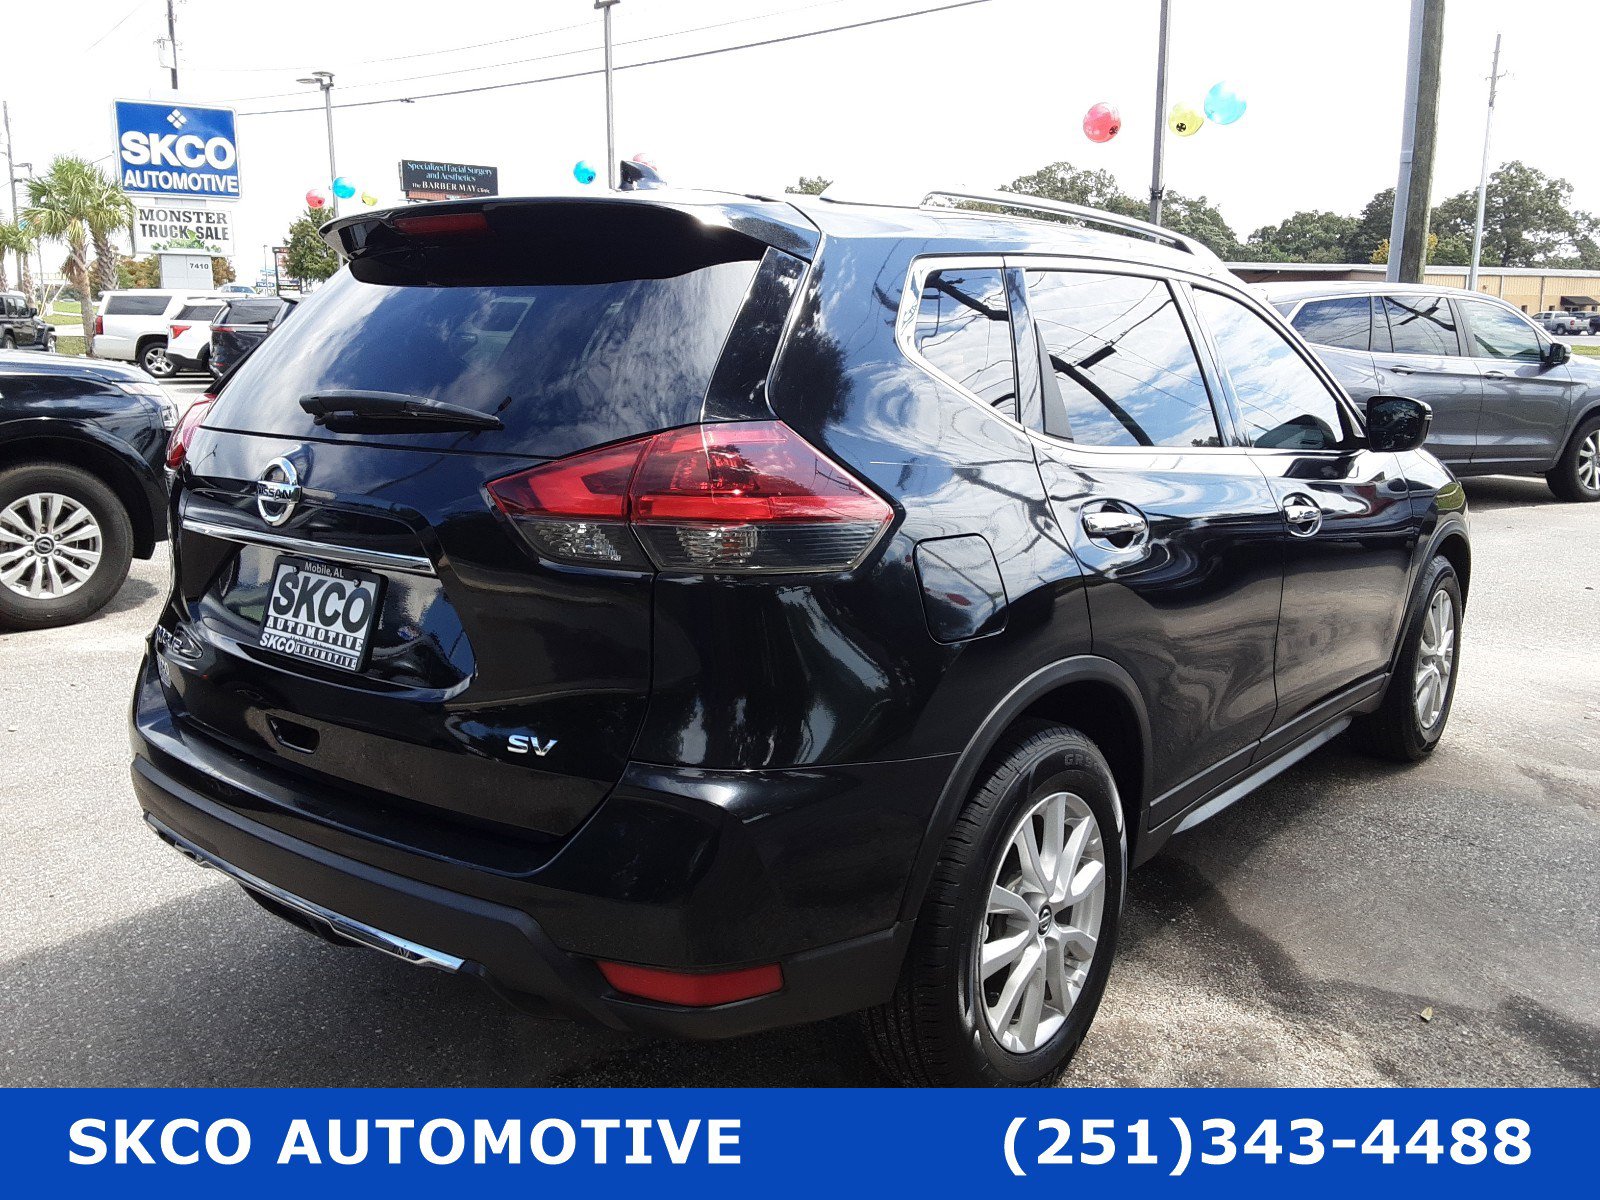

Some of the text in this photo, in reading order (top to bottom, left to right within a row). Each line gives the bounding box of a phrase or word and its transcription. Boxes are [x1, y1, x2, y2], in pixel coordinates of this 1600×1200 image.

[121, 130, 236, 170] SKCO
[407, 162, 493, 177] Specialized Facial Surgery
[426, 171, 476, 182] and Aesthetics
[124, 169, 239, 193] AUTOMOTIVE
[422, 180, 457, 191] BARBER
[458, 184, 477, 193] MAY
[139, 208, 228, 225] MONSTER
[140, 223, 229, 241] TRUCK SALE
[190, 262, 209, 270] 7410
[304, 561, 344, 579] Mobile, AL
[272, 571, 372, 634] SKCO
[266, 615, 364, 652] AUTOMOTIVE
[259, 632, 296, 654] SKCO
[295, 643, 357, 668] AUTOMOTIVE
[507, 734, 558, 757] SV
